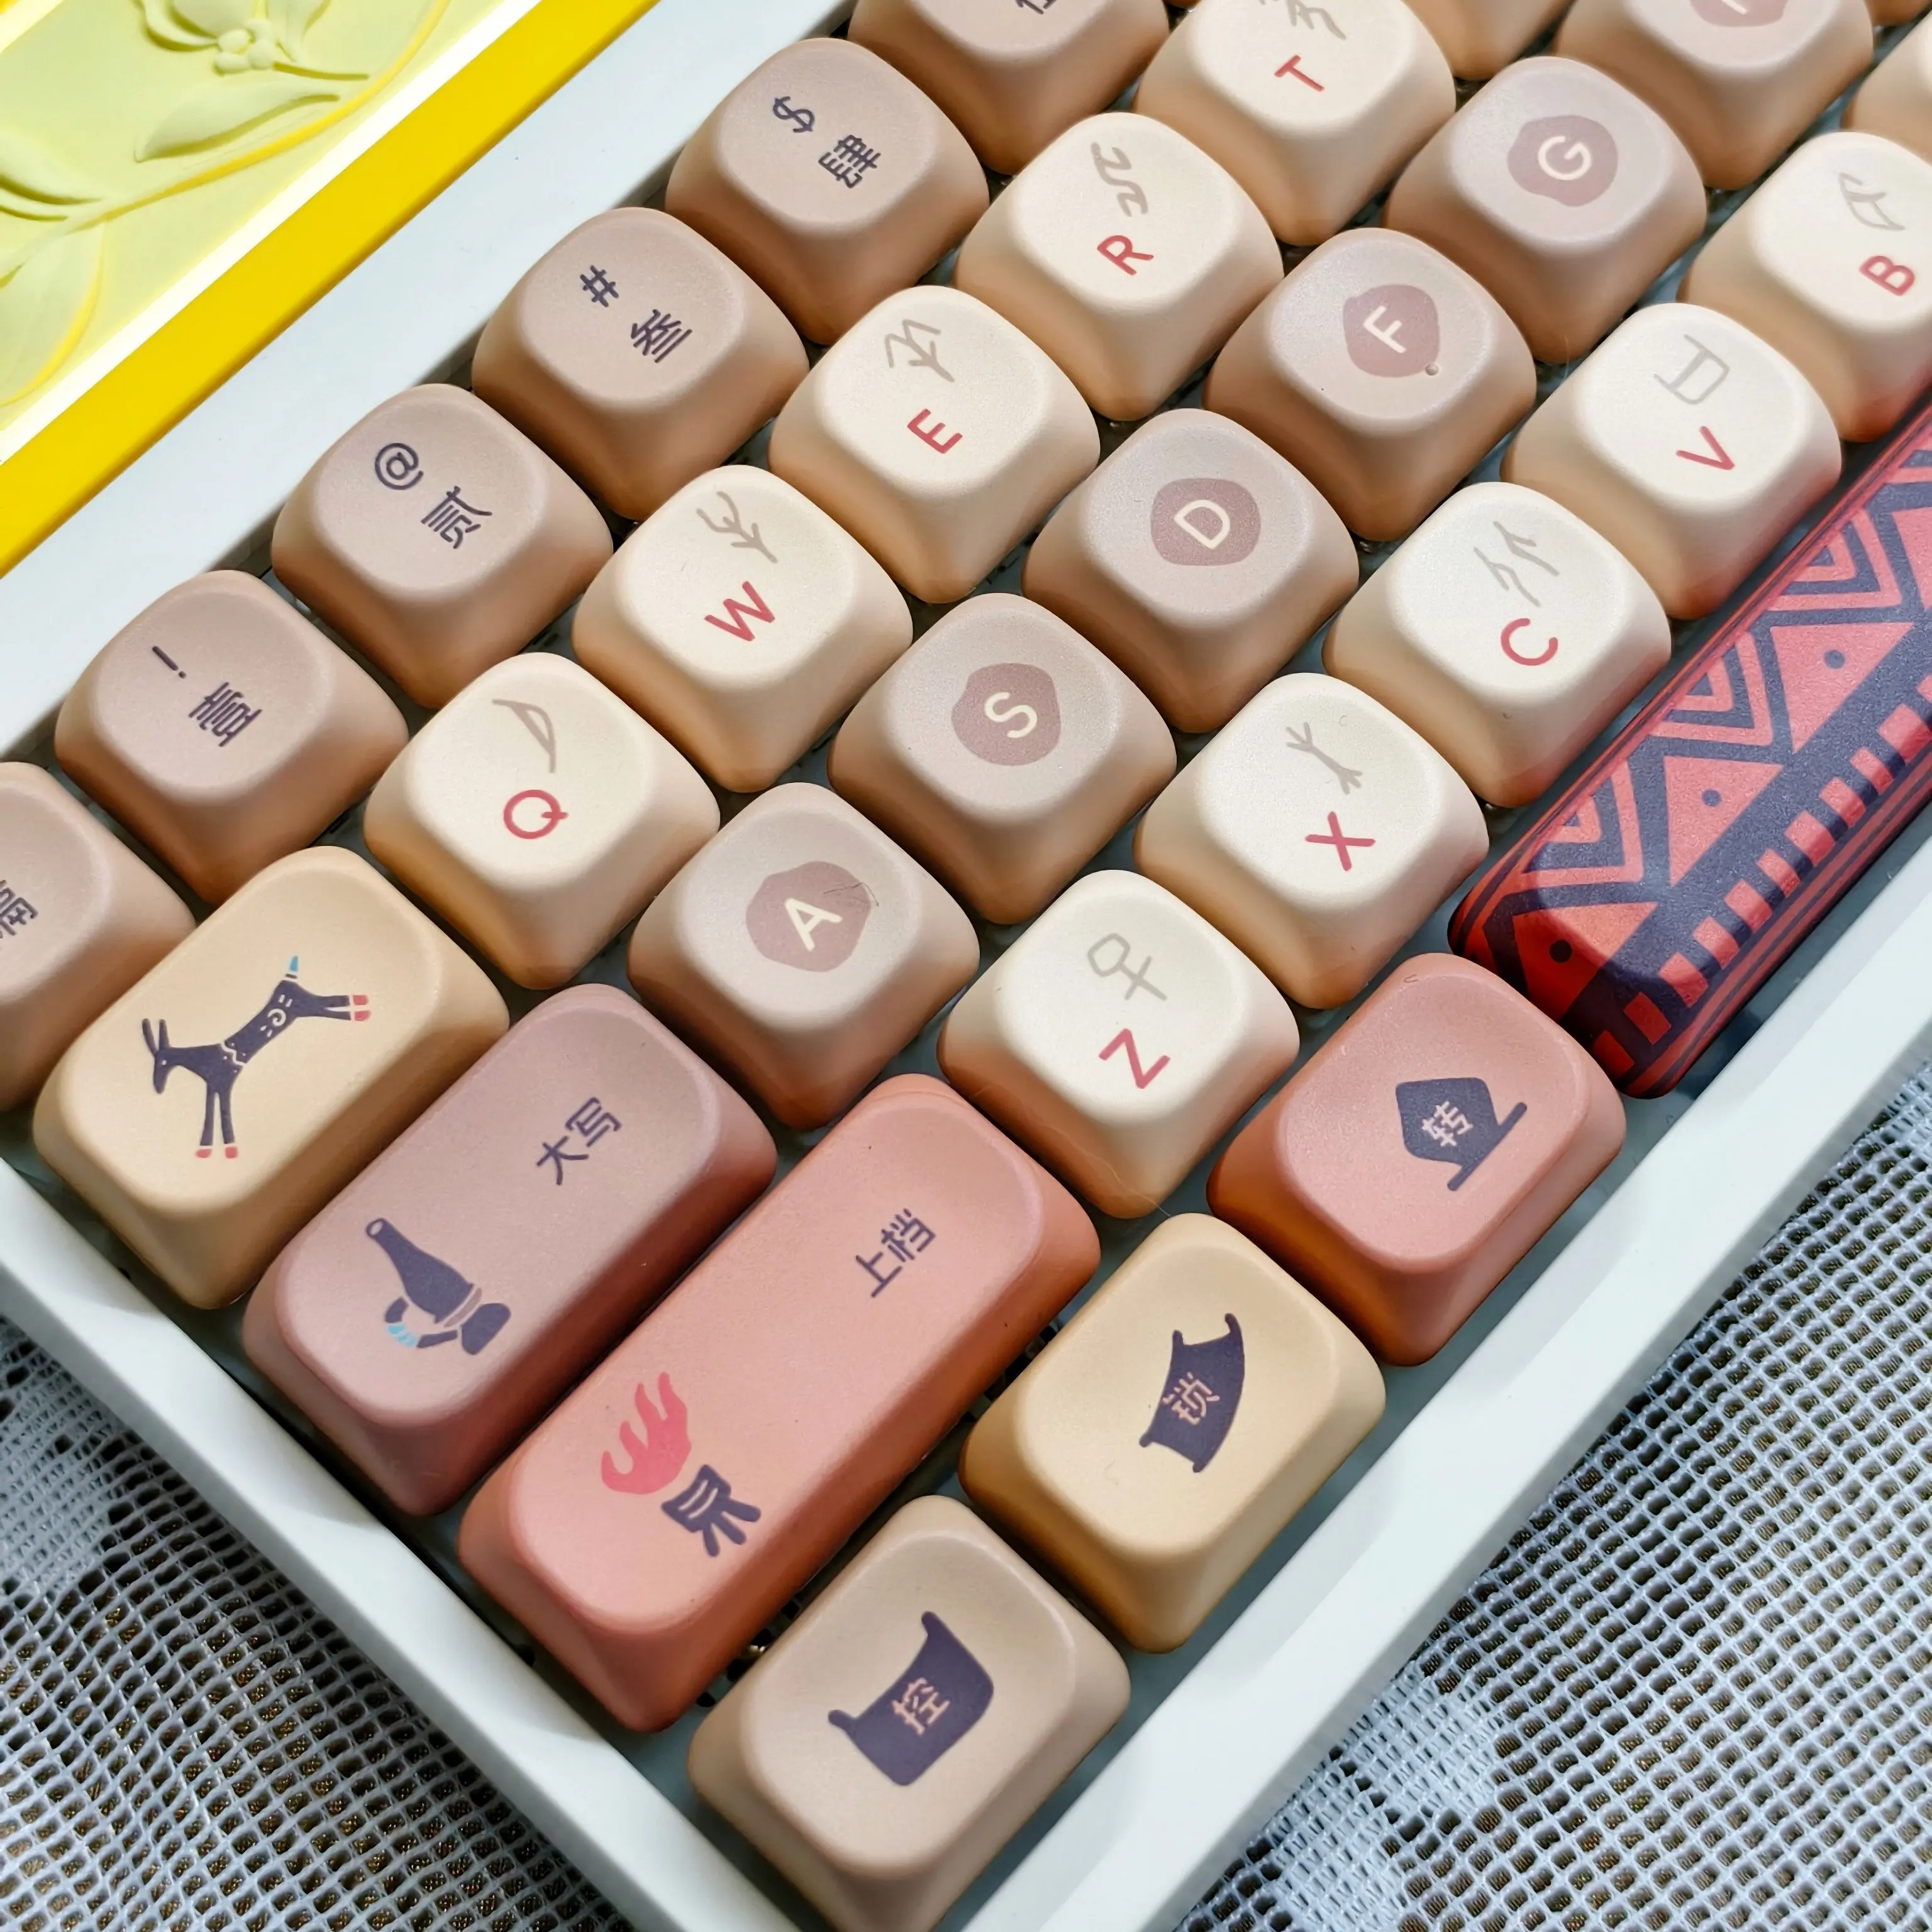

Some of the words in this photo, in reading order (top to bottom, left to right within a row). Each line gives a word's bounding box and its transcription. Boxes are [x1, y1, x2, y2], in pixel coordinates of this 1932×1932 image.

[1275, 56, 1323, 92] T
[772, 96, 815, 133] $
[818, 134, 881, 189] 肆
[1538, 135, 1592, 180] G
[1097, 235, 1153, 276] R
[1860, 255, 1916, 296] B
[580, 265, 619, 308] #
[630, 309, 692, 364] 叁
[1362, 306, 1406, 354] F
[907, 408, 963, 454] E
[1676, 426, 1735, 470] V
[374, 443, 424, 491] @
[421, 486, 492, 550] 贰
[1174, 499, 1231, 550] D
[704, 581, 775, 642] W
[152, 645, 187, 679] !
[1500, 618, 1558, 666] C
[189, 682, 262, 747] 壹
[984, 692, 1038, 738] S
[503, 789, 569, 840] Q
[1305, 811, 1375, 872] X
[784, 897, 843, 952] A
[1098, 1028, 1170, 1090] Z
[536, 1097, 622, 1186] 大写
[1422, 1101, 1473, 1147] 转
[855, 1208, 936, 1298] 上档
[1162, 1371, 1220, 1424] 锁
[891, 1676, 950, 1736] 控
